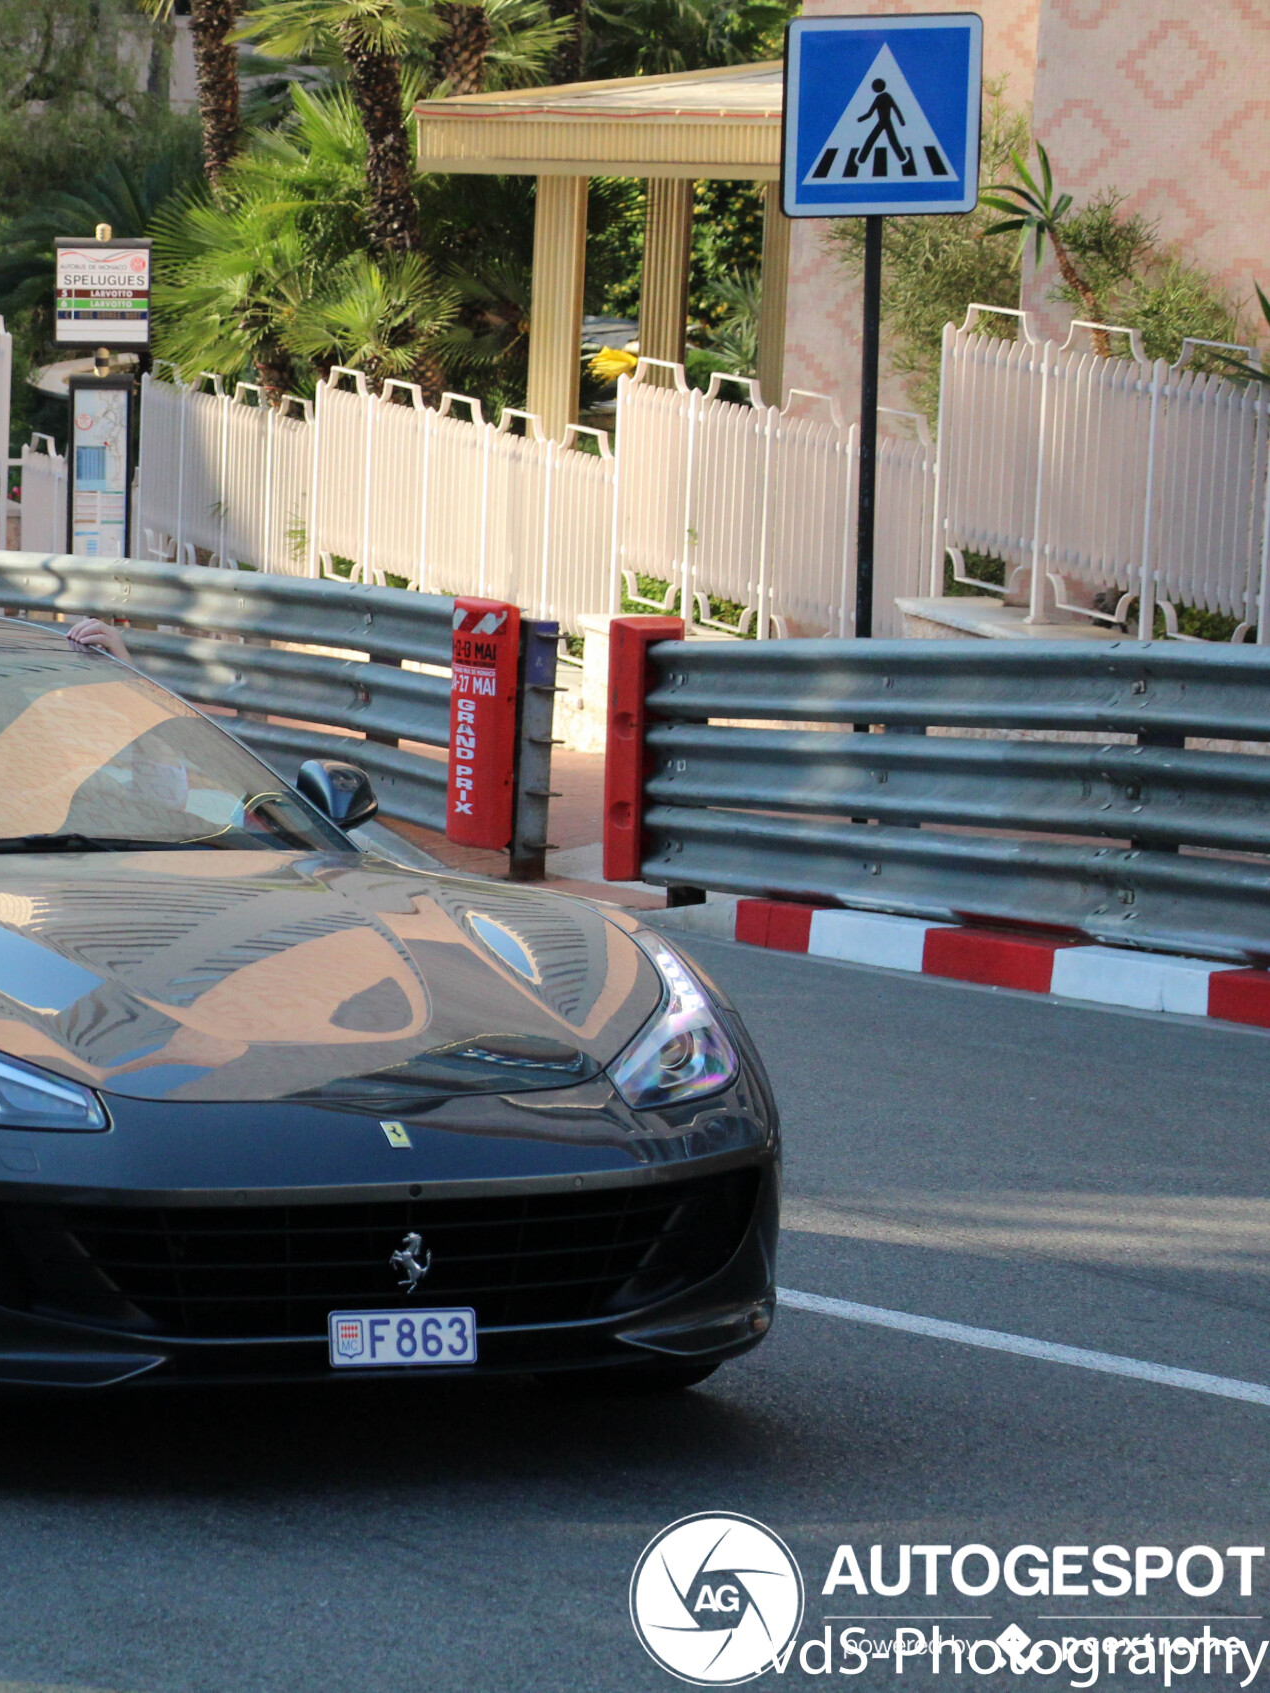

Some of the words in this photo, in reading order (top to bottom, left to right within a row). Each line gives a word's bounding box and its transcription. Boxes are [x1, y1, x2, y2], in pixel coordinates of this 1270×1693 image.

[63, 274, 145, 286] SPELUGUES
[61, 289, 68, 297] 5
[61, 300, 68, 308] 6
[90, 300, 133, 308] LARVOTTO
[474, 642, 497, 660] MAI
[472, 676, 497, 696] MAI
[456, 698, 476, 760] GRAND
[454, 764, 474, 815] PRIX
[341, 1339, 358, 1351] MC
[368, 1317, 468, 1359] F863
